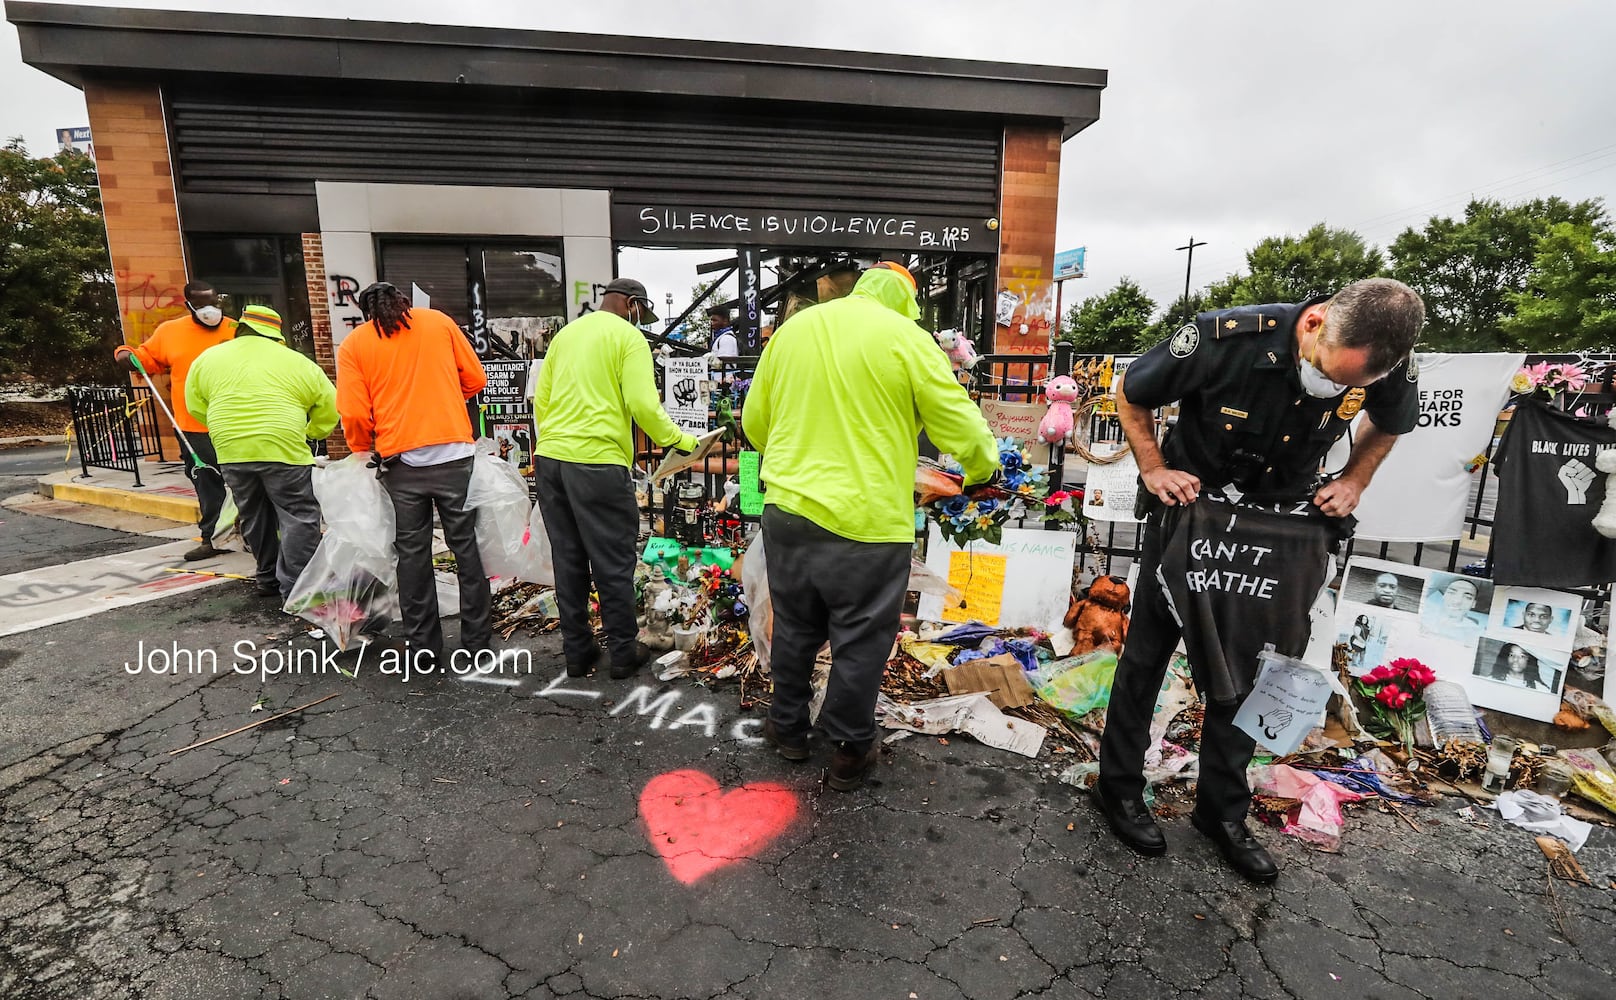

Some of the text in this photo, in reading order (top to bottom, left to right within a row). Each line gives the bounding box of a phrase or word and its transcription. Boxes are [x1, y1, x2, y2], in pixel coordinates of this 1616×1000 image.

[639, 207, 752, 234] SILENCE
[761, 216, 780, 232] IS
[920, 231, 956, 252] BLM
[942, 226, 970, 242] 125
[486, 371, 509, 380] ISARM
[483, 386, 520, 395] THE POLICE
[486, 379, 510, 388] EFUND
[1433, 389, 1464, 400] FOR
[1562, 443, 1590, 457] LIVES
[1020, 543, 1067, 561] NAME
[1190, 538, 1273, 567] CAN'T
